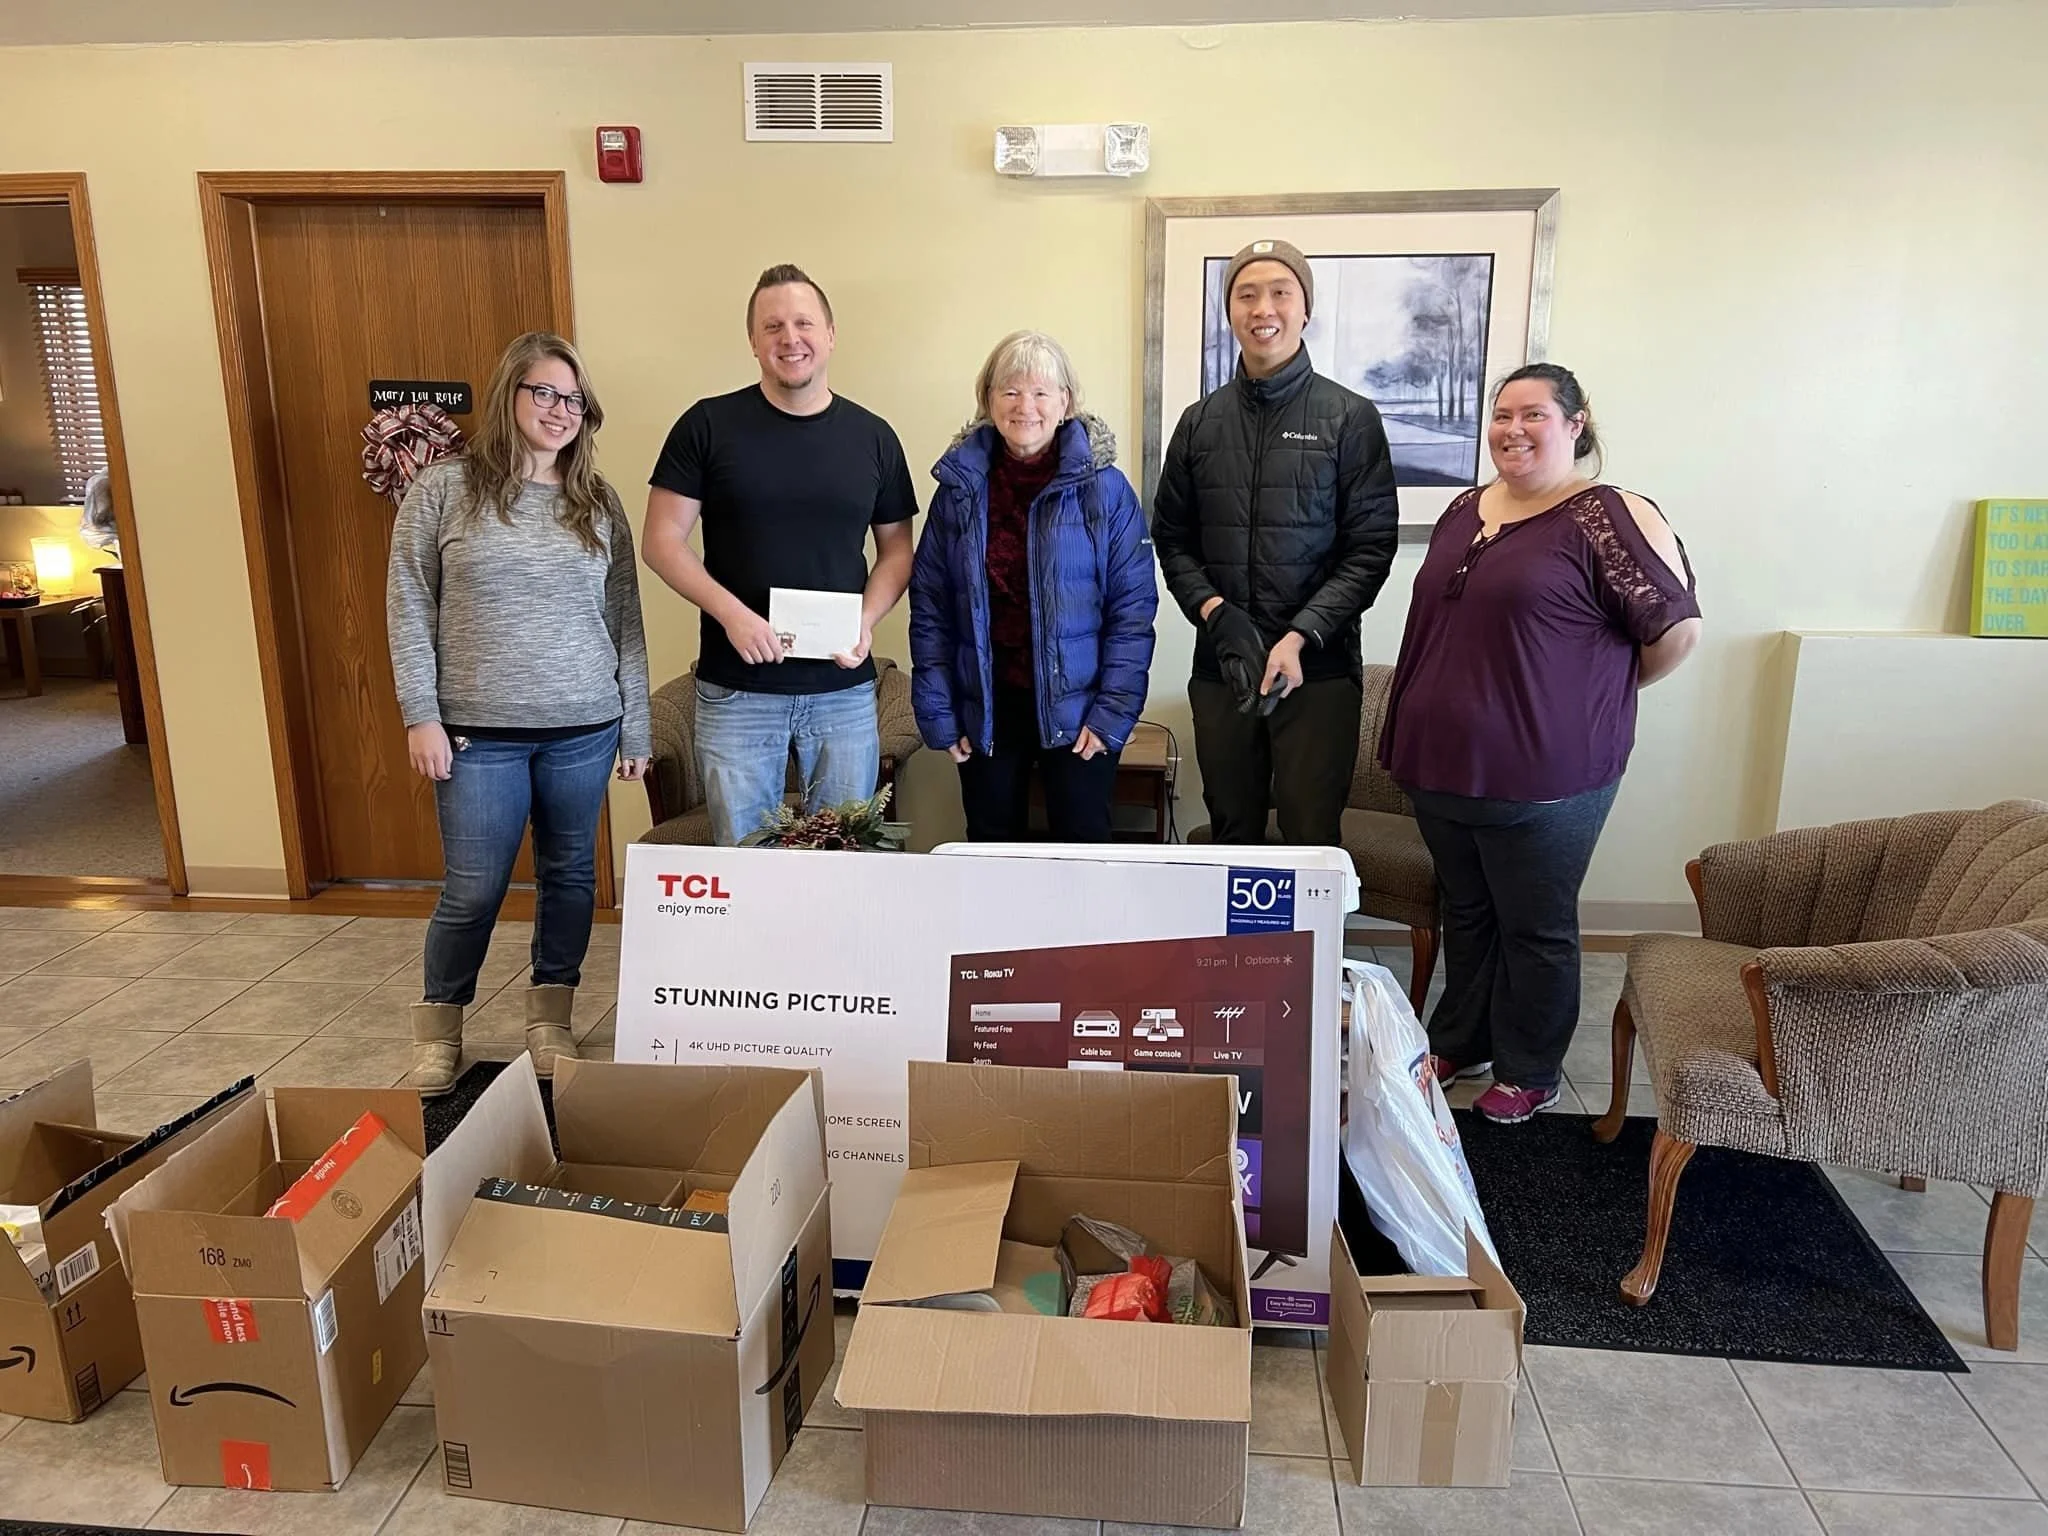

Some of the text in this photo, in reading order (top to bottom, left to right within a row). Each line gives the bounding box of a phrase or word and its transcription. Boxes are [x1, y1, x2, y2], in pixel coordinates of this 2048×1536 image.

[373, 390, 404, 402] Mary
[410, 391, 429, 403] Lou
[1289, 431, 1318, 441] Columbia
[1989, 533, 2048, 550] TOO LAT
[1988, 560, 2048, 576] TO STAR
[1987, 587, 2013, 604] THE
[657, 874, 730, 899] TCL
[657, 902, 691, 916] enjoy
[1213, 958, 1228, 968] pm
[1245, 955, 1280, 966] Options
[961, 970, 978, 979] TCL
[1004, 968, 1015, 977] TV
[654, 987, 897, 1016] STUNNING PICTURE.
[975, 1008, 991, 1017] Home
[974, 1024, 1013, 1033] Featured Free
[689, 1041, 833, 1056] 4K UHD PICTURE QUALITY
[974, 1041, 997, 1050] My Feed
[1080, 1047, 1112, 1056] Cable box
[1134, 1049, 1181, 1058] Game console
[1213, 1051, 1242, 1060] Live TV
[973, 1057, 992, 1065] Search
[857, 1118, 901, 1128] SCREEN
[843, 1150, 904, 1163] CHANNELS
[199, 1247, 226, 1266] 168
[234, 1322, 247, 1343] less
